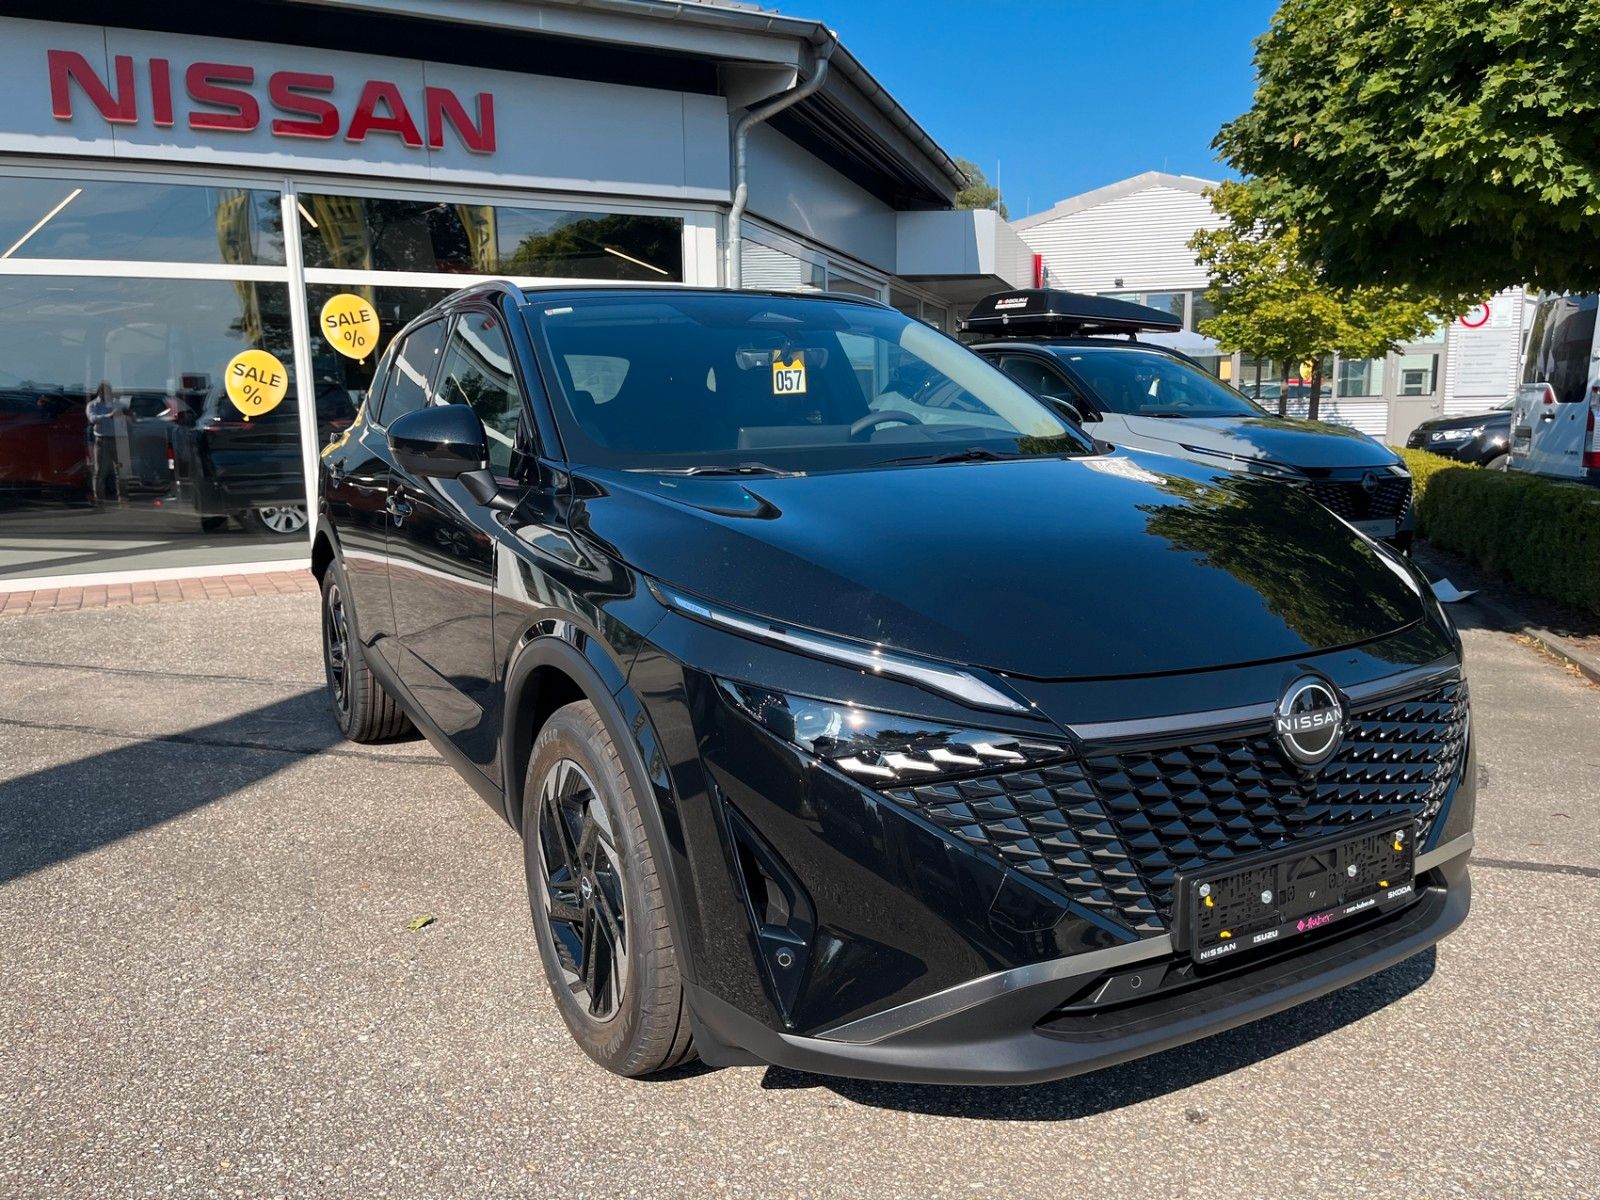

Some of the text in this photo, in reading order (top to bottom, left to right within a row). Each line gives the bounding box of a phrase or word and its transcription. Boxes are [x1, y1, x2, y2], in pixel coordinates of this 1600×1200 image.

[47, 49, 497, 154] NISSAN
[325, 309, 372, 328] SALE
[343, 330, 366, 348] %
[232, 363, 281, 388] SALE
[776, 370, 802, 391] 057
[242, 384, 263, 406] %
[1277, 709, 1342, 731] NISSAN
[1200, 942, 1237, 960] NISSAN
[1252, 929, 1279, 944] ISUZU
